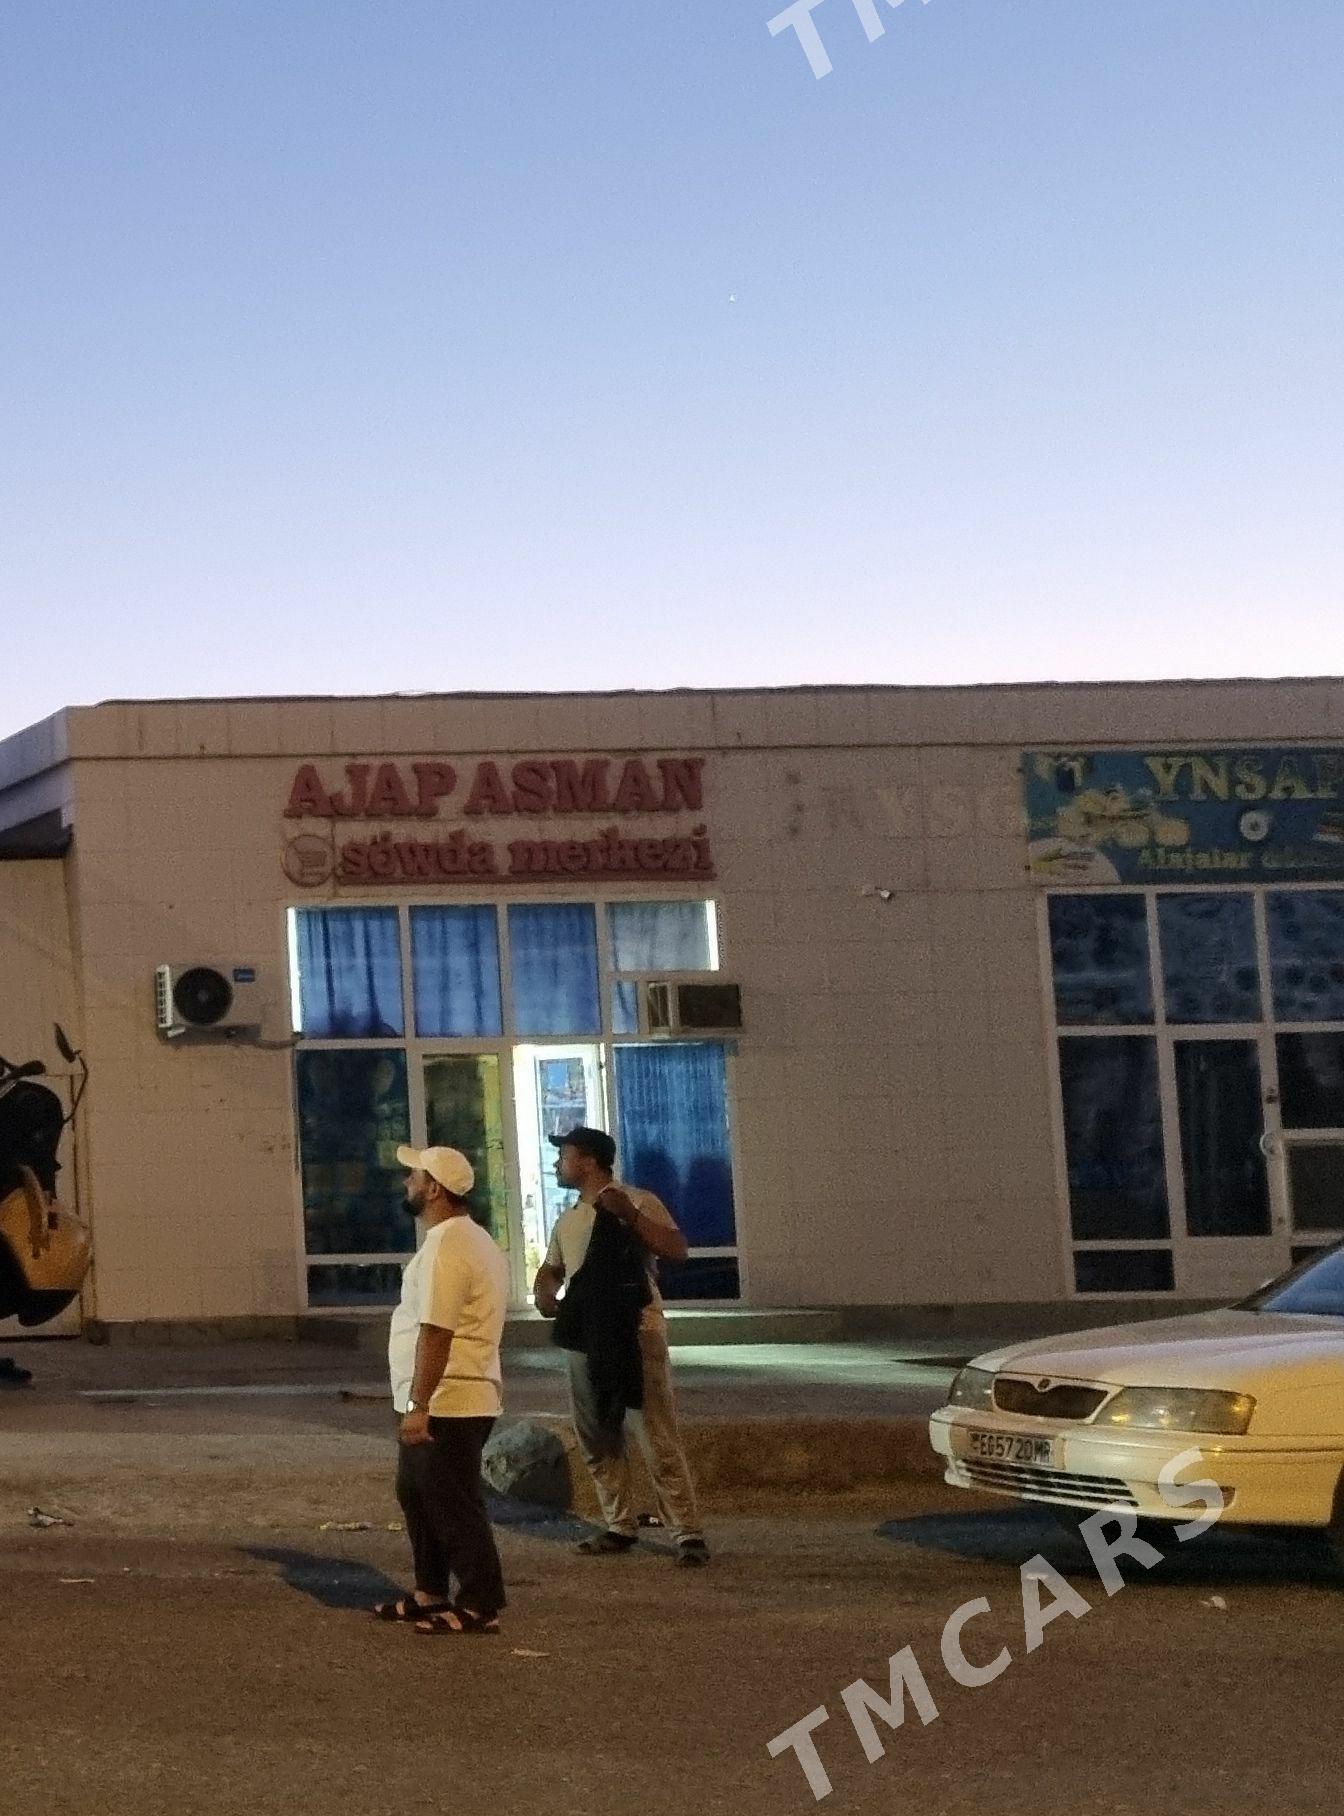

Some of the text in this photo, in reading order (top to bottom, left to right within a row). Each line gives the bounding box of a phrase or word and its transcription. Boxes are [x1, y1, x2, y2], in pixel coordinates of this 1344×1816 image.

[283, 757, 707, 819] AJAP ASMAN
[508, 823, 715, 875] merkezi
